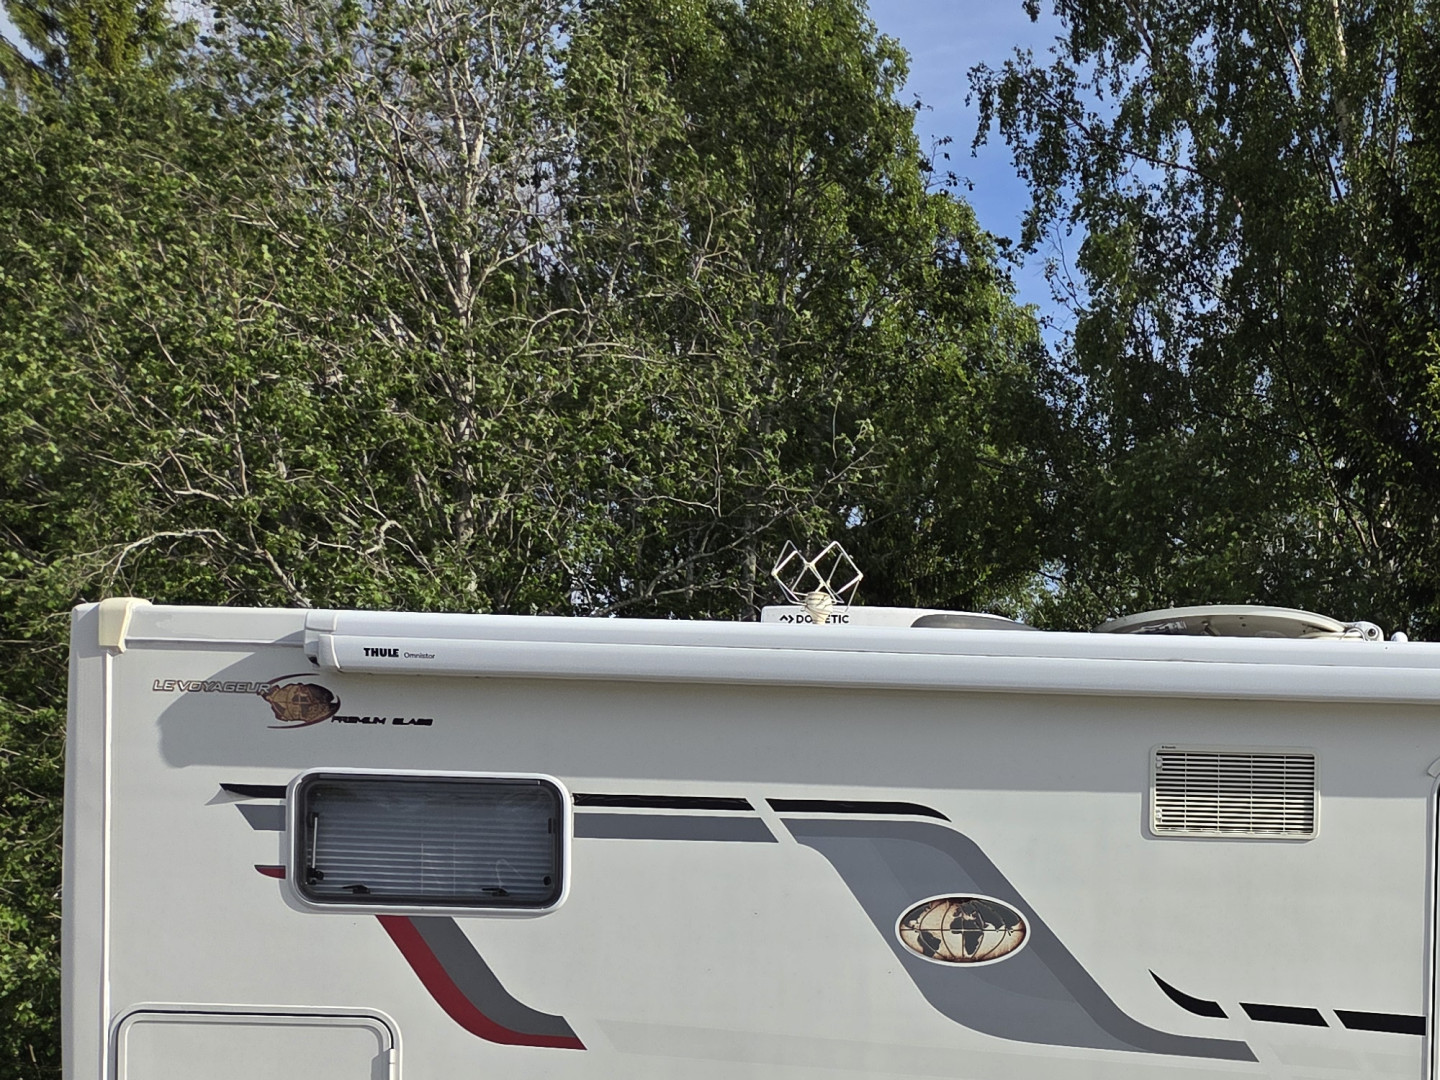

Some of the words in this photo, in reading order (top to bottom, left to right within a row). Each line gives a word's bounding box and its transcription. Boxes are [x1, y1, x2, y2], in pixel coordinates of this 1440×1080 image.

[796, 614, 850, 624] DOETIC
[363, 647, 400, 658] THULE
[152, 680, 175, 692] LE
[176, 680, 272, 694] VOYAGEUR
